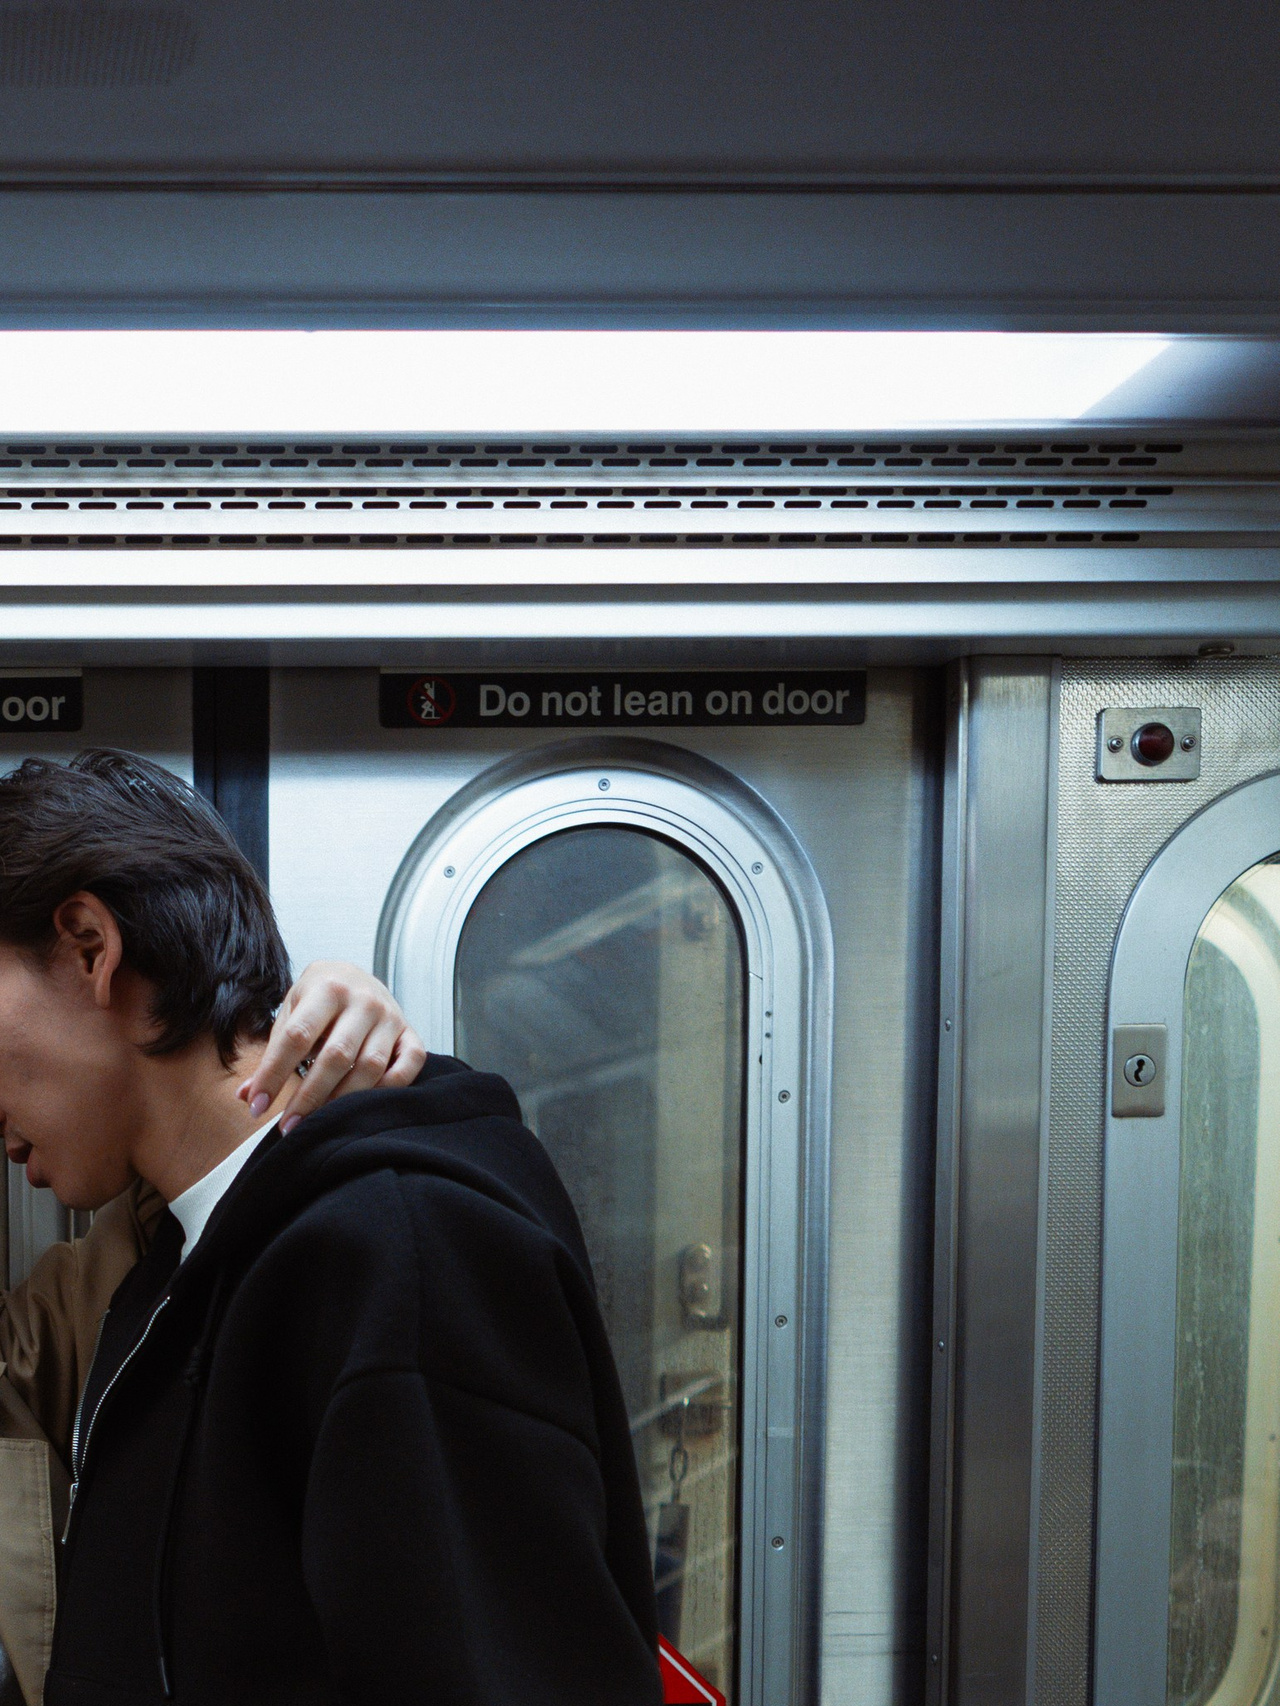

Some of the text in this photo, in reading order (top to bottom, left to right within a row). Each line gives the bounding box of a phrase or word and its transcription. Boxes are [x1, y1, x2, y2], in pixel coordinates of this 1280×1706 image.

[479, 683, 849, 717] Do not lean on door
